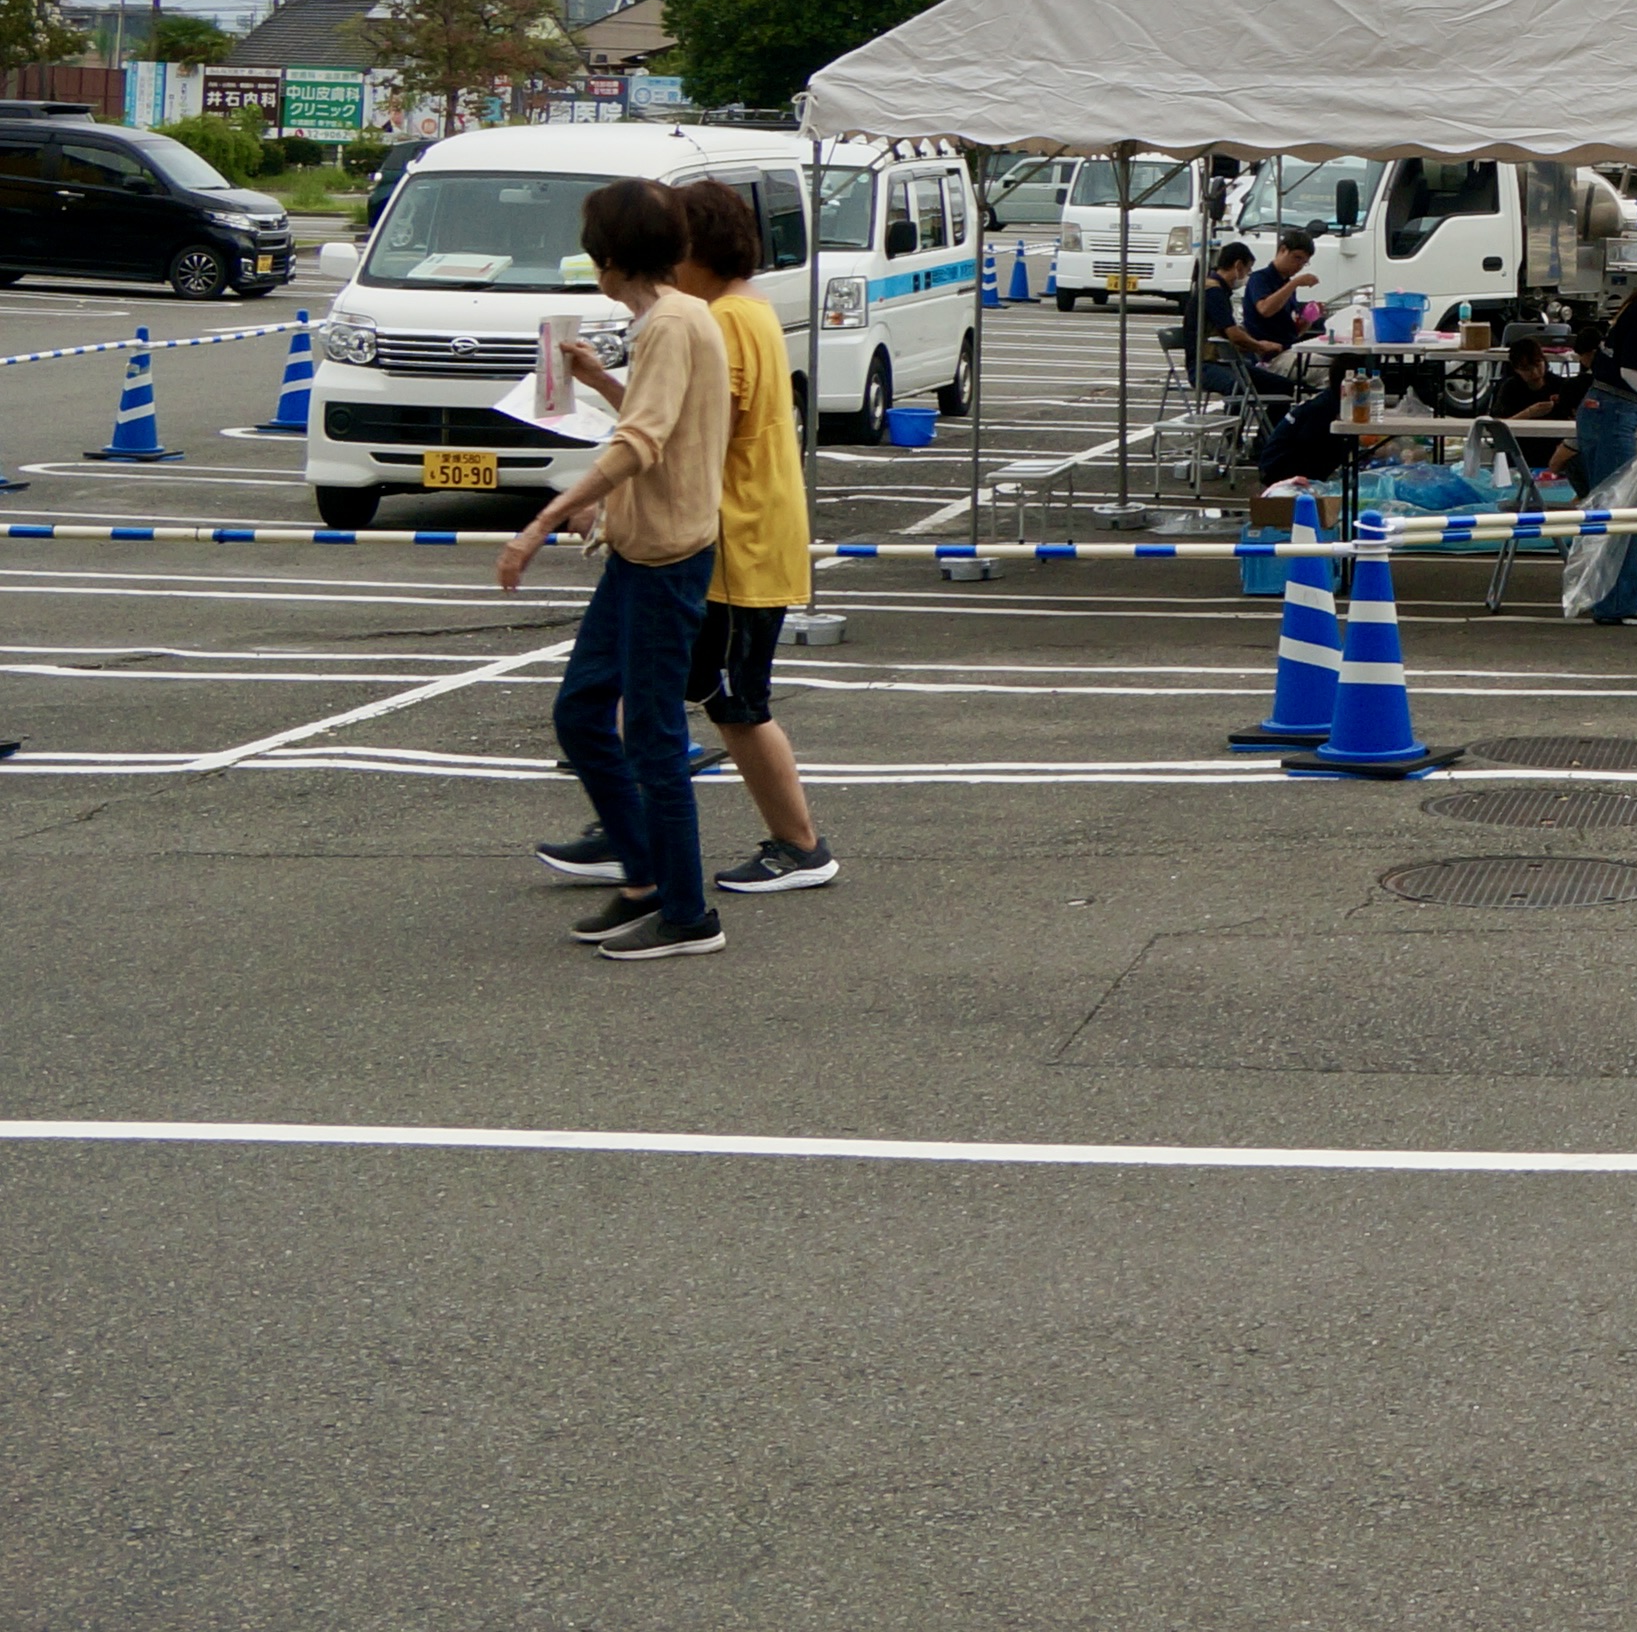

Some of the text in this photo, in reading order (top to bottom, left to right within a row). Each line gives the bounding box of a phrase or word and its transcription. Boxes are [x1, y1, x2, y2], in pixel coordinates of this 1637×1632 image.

[206, 90, 277, 108] 井石内科
[286, 84, 361, 103] 中山皮膚科
[290, 103, 357, 118] クリニック
[461, 454, 481, 464] 580
[440, 466, 493, 486] 50-90
